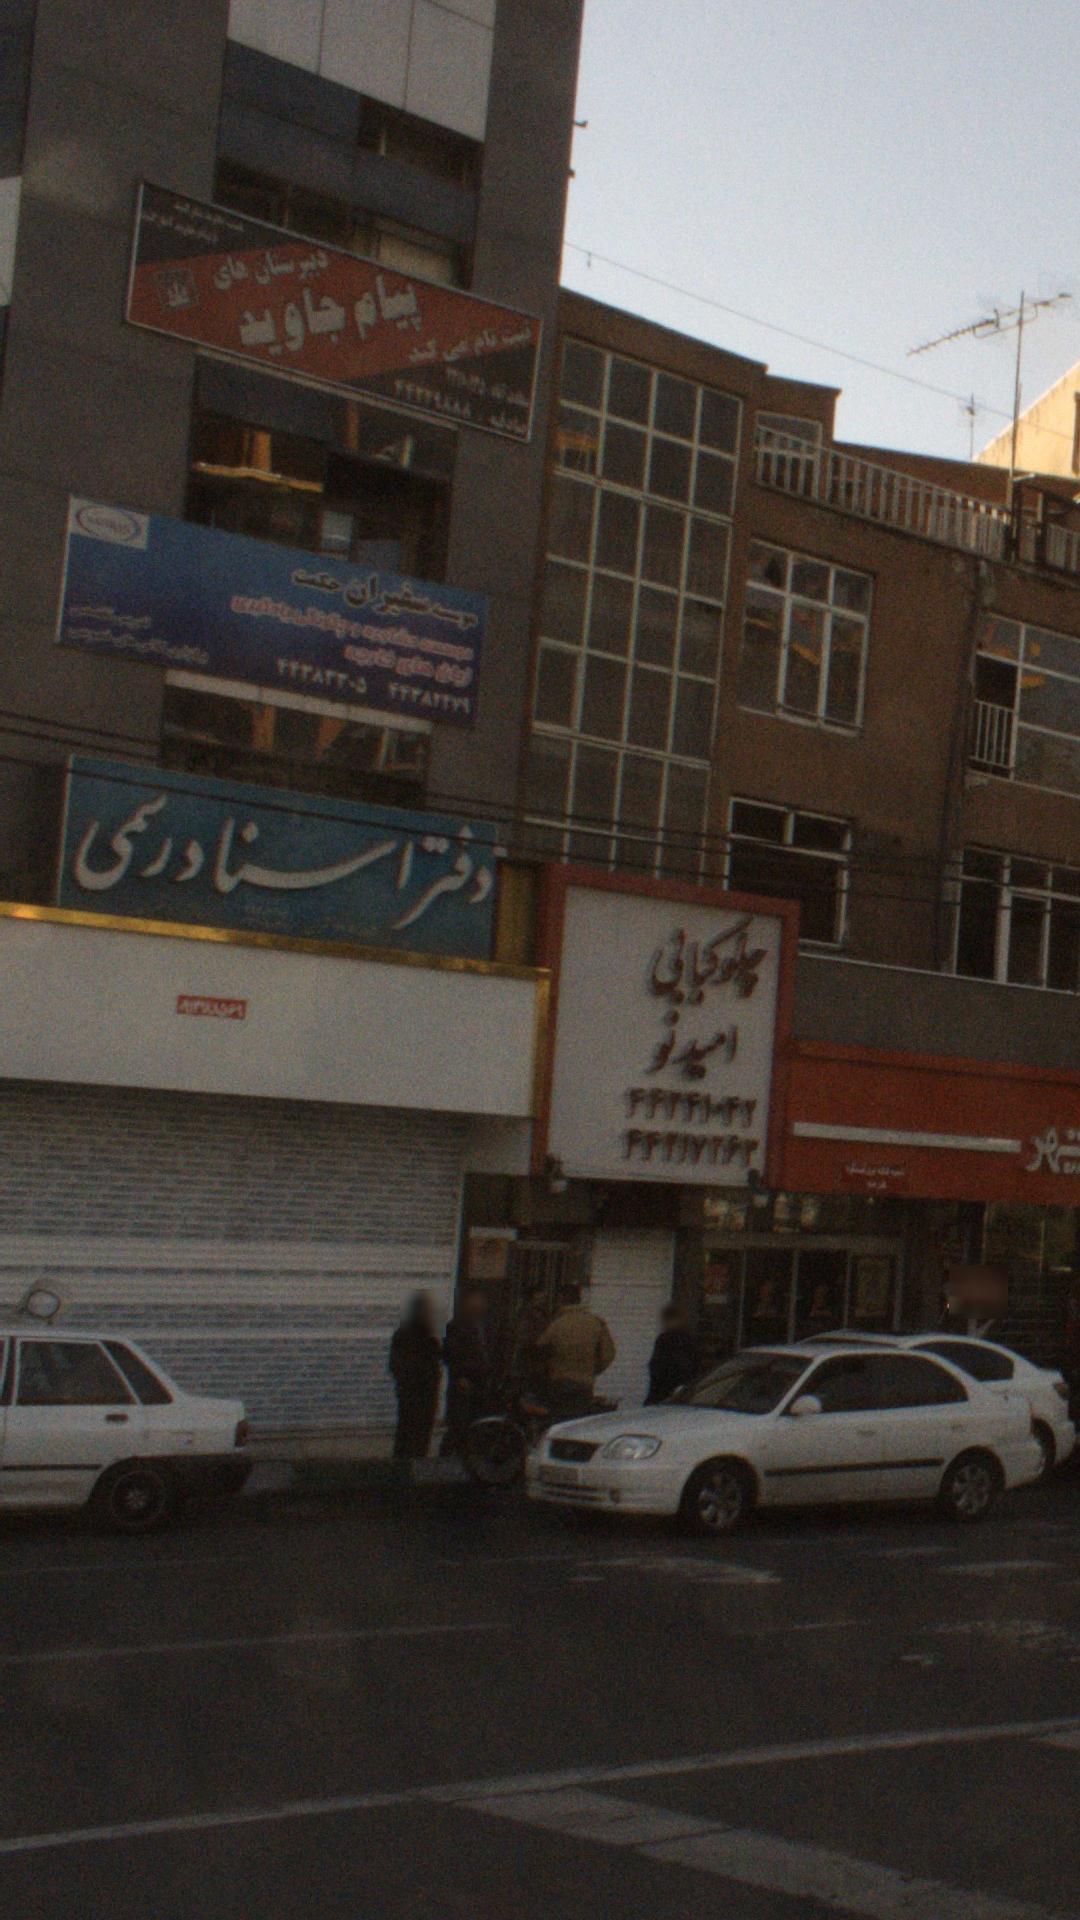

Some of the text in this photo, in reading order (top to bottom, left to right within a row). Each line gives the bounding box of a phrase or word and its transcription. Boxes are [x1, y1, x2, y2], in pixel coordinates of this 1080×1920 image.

[213, 255, 249, 291] های
[238, 287, 346, 356] جاوید
[354, 274, 422, 339] پیام
[408, 337, 437, 362] کند
[442, 340, 469, 362] می
[475, 329, 498, 358] نام
[74, 792, 494, 931] دفتر اسناد رسمی
